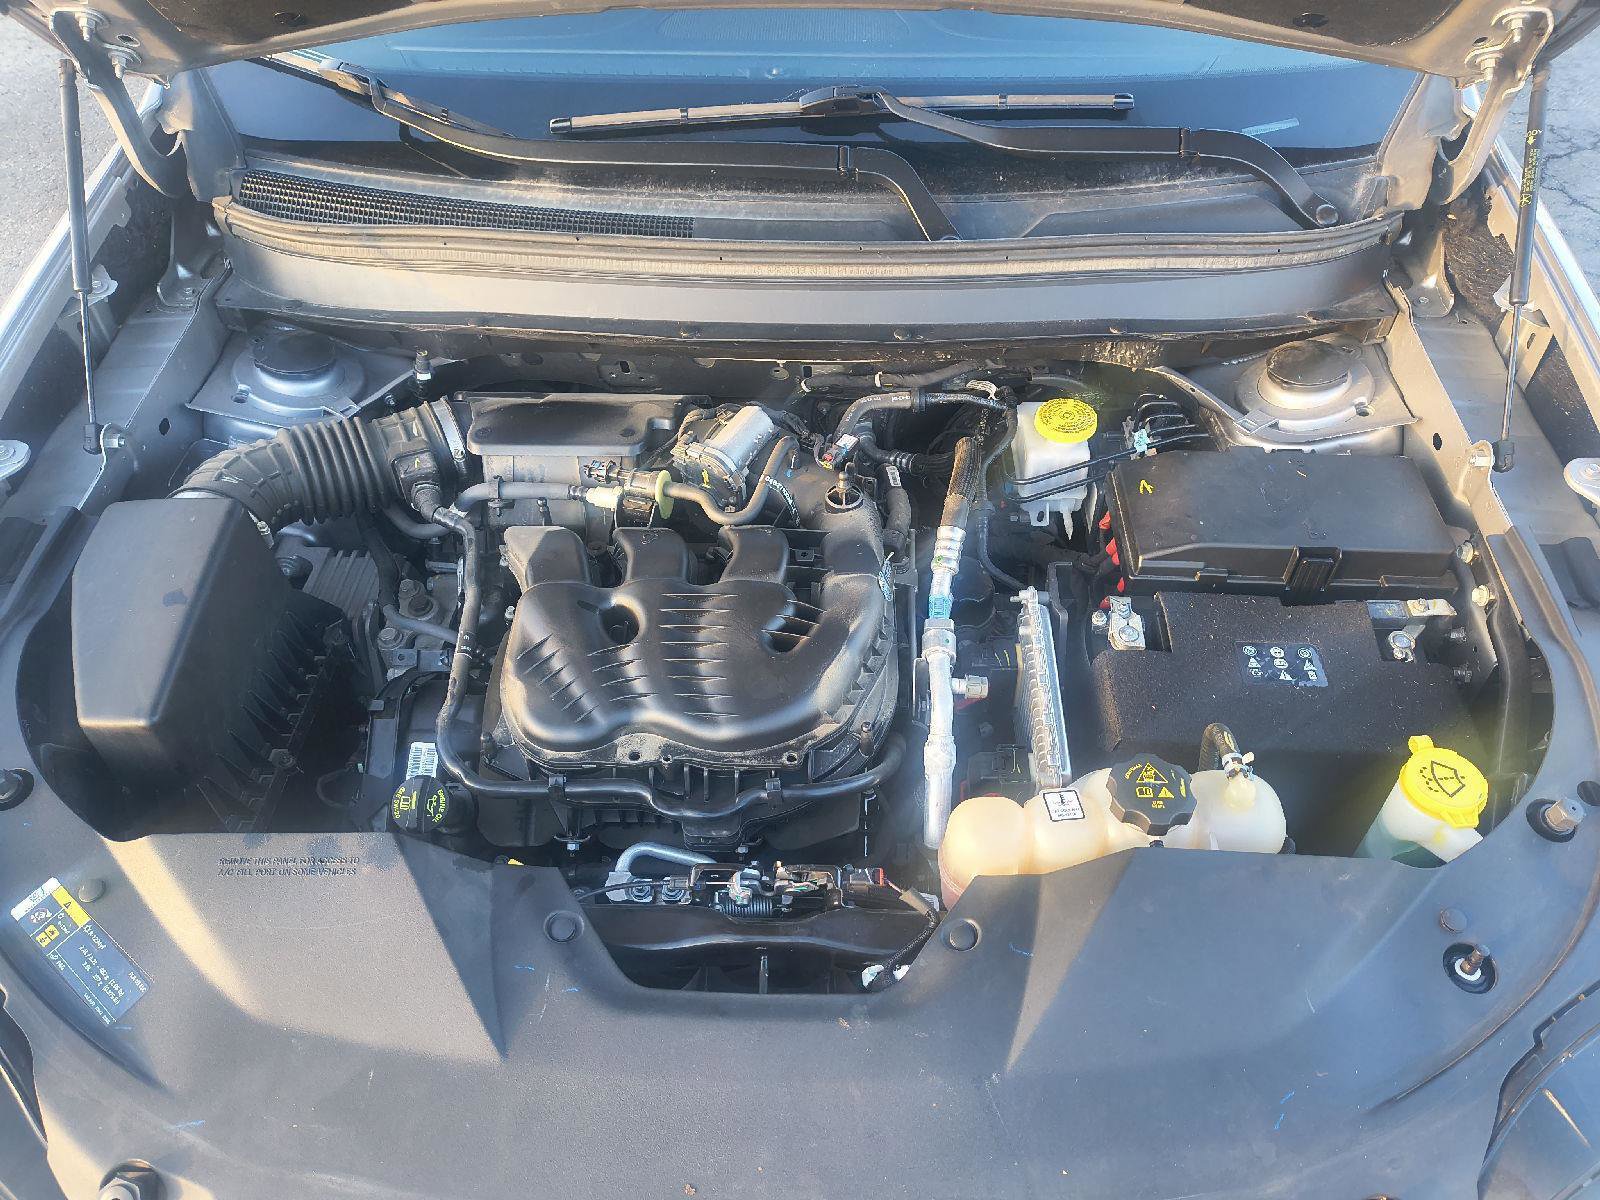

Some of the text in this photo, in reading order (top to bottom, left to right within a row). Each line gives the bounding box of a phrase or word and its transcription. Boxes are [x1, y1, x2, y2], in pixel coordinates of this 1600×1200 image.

[396, 787, 405, 799] SAE
[432, 789, 446, 823] ENGINE OIL
[254, 857, 271, 865] THIS
[272, 857, 298, 865] PANEL
[299, 856, 315, 865] FOR
[350, 856, 360, 865] TO
[255, 867, 276, 876] PORT
[278, 867, 291, 876] ON
[318, 867, 357, 876] VEHICLES
